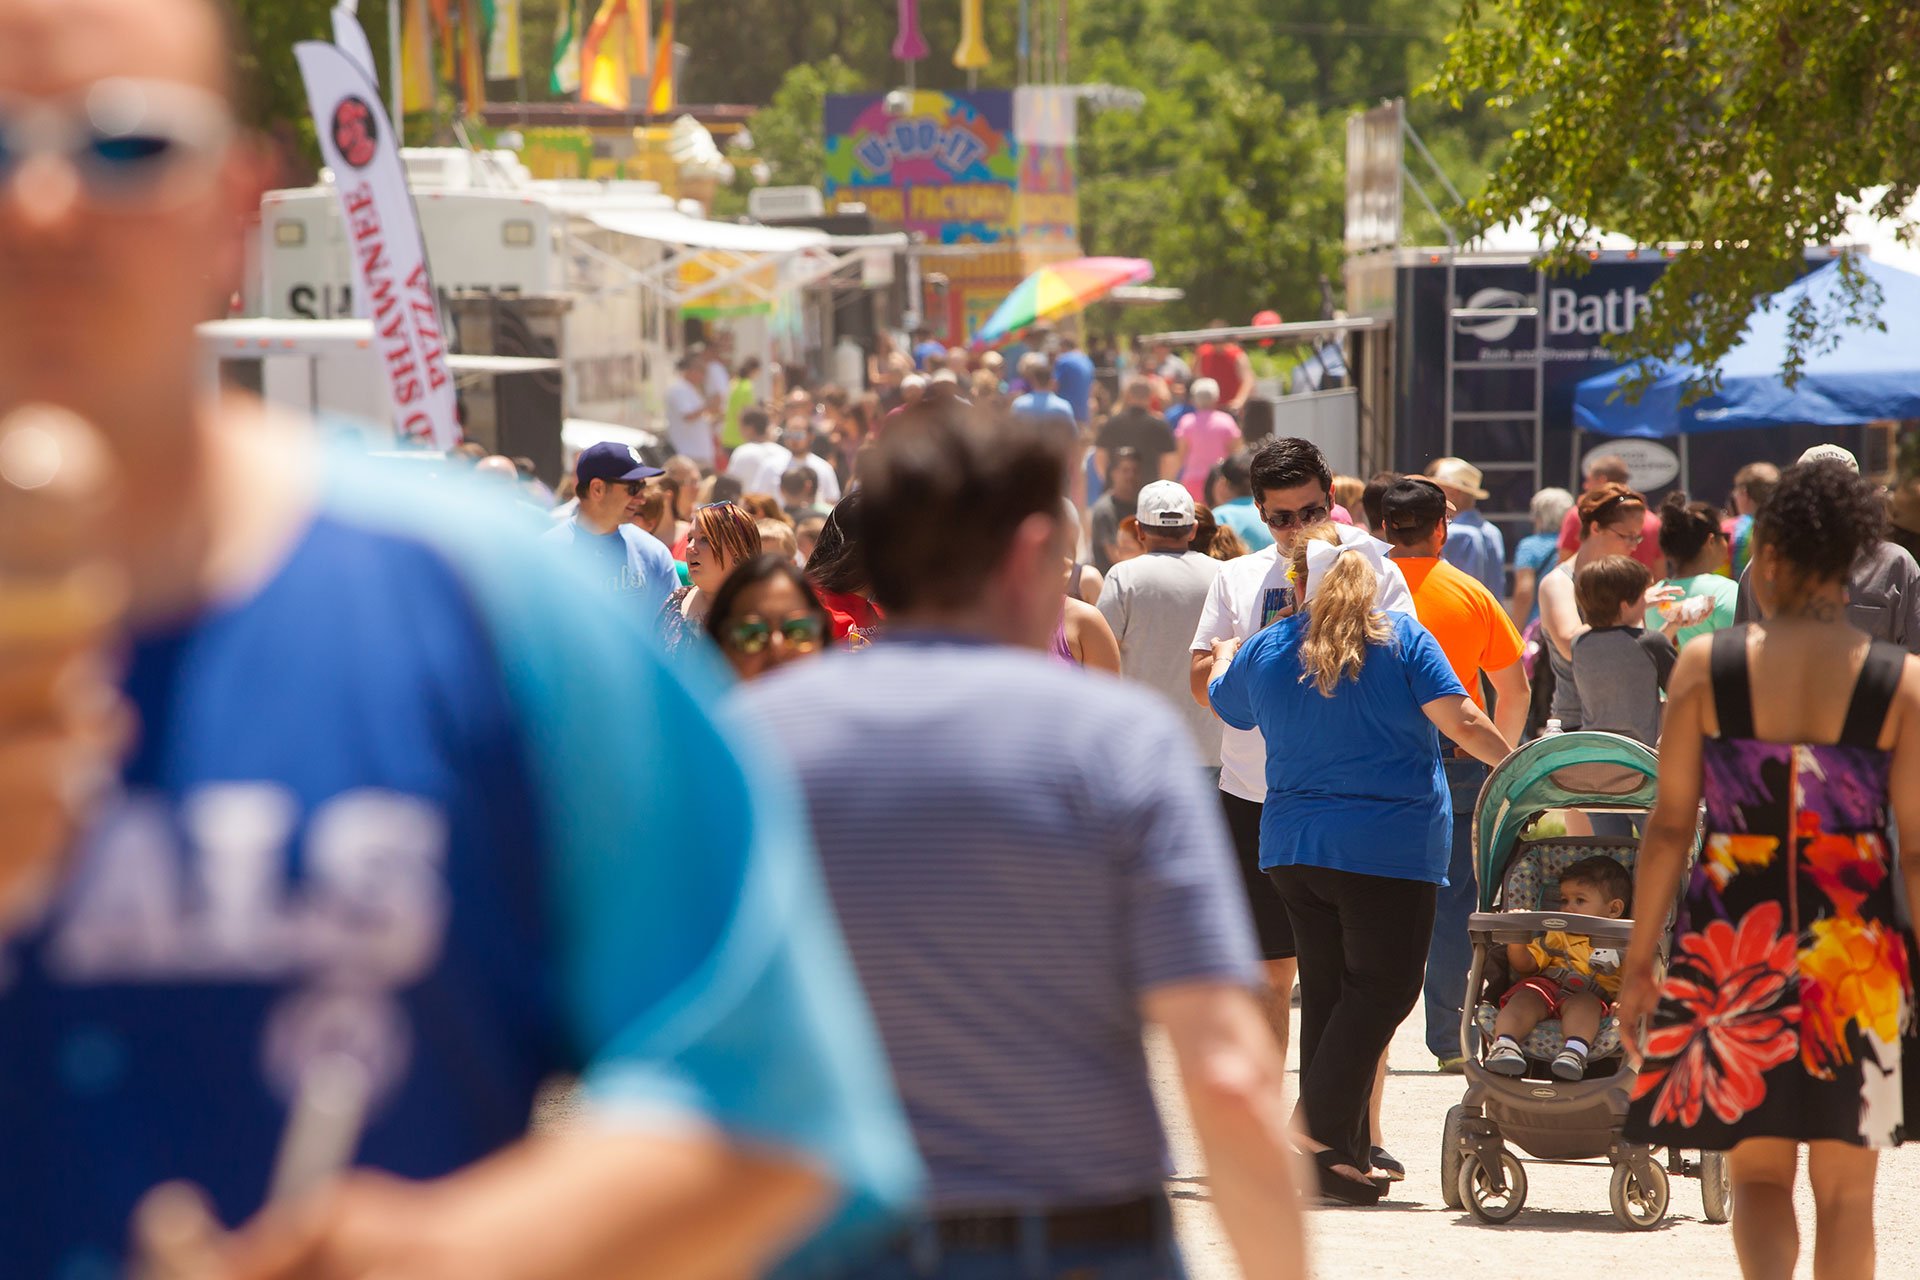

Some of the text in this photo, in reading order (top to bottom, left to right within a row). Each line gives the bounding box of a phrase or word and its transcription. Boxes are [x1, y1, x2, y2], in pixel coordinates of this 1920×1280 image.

[856, 120, 985, 171] U-DO-IT
[343, 181, 424, 407] SHAWNEE
[405, 262, 447, 391] PIZZA
